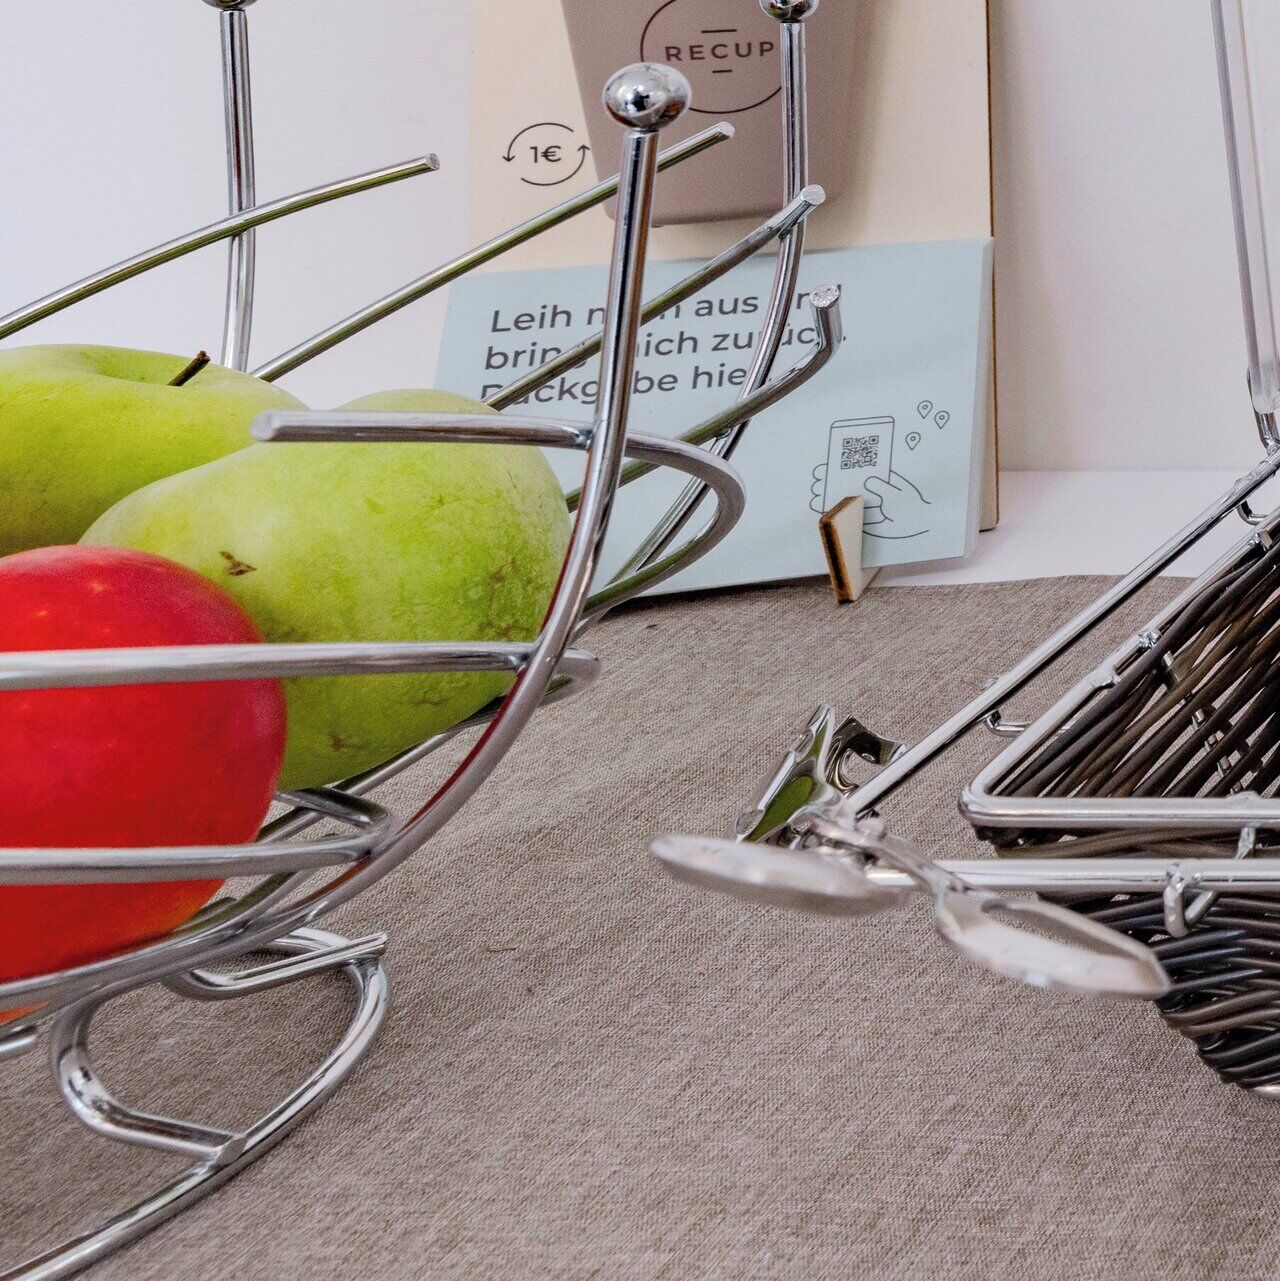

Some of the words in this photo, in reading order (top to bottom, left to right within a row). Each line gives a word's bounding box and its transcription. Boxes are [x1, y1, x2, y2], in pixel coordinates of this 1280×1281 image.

[665, 41, 774, 61] RECUP
[530, 145, 562, 163] 1€
[491, 304, 573, 333] Leih
[694, 296, 759, 317] aus
[485, 341, 587, 370] brin
[636, 330, 698, 357] ich
[691, 363, 748, 389] hie
